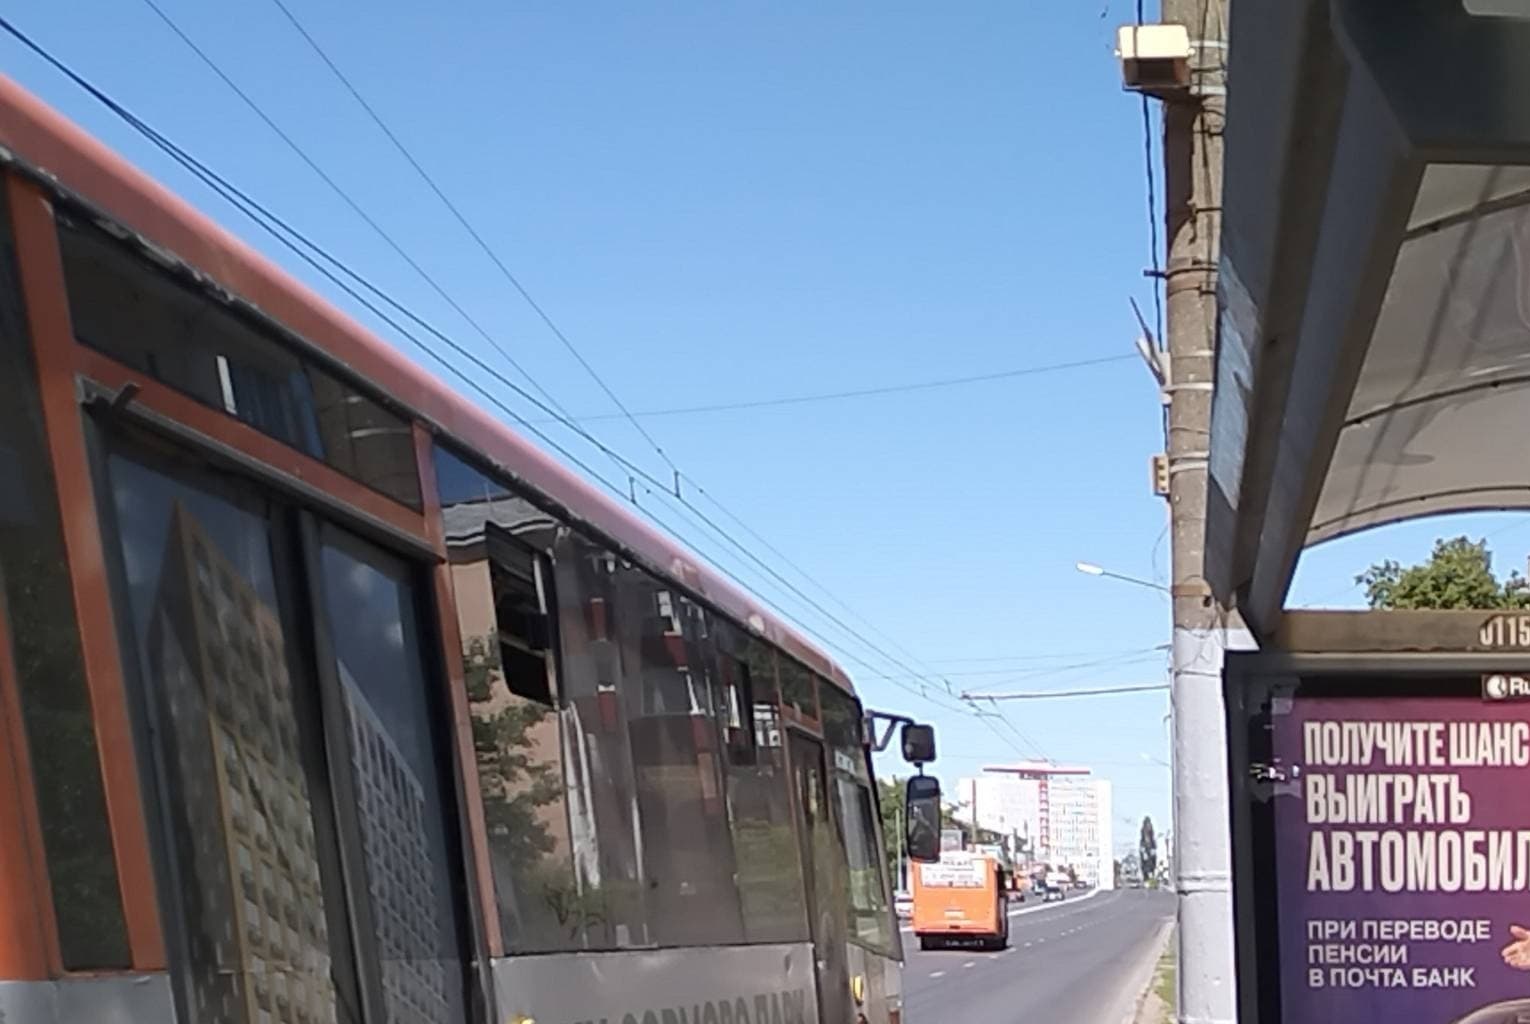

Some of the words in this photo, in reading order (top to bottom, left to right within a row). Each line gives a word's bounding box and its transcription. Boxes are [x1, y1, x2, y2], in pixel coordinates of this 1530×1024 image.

[1304, 721, 1443, 766] ПОЛУЧИТЕ
[1450, 720, 1530, 767] ШАНС
[1306, 774, 1471, 824] ВЫИГРАТЬ
[1308, 921, 1357, 941] ПРИ
[1362, 920, 1491, 942] ПЕРЕВОДЕ
[1308, 945, 1408, 964] ПЕНСИИ
[1308, 968, 1325, 988] В
[1330, 968, 1410, 987] ПОЧТА
[1412, 967, 1476, 987] БАНК
